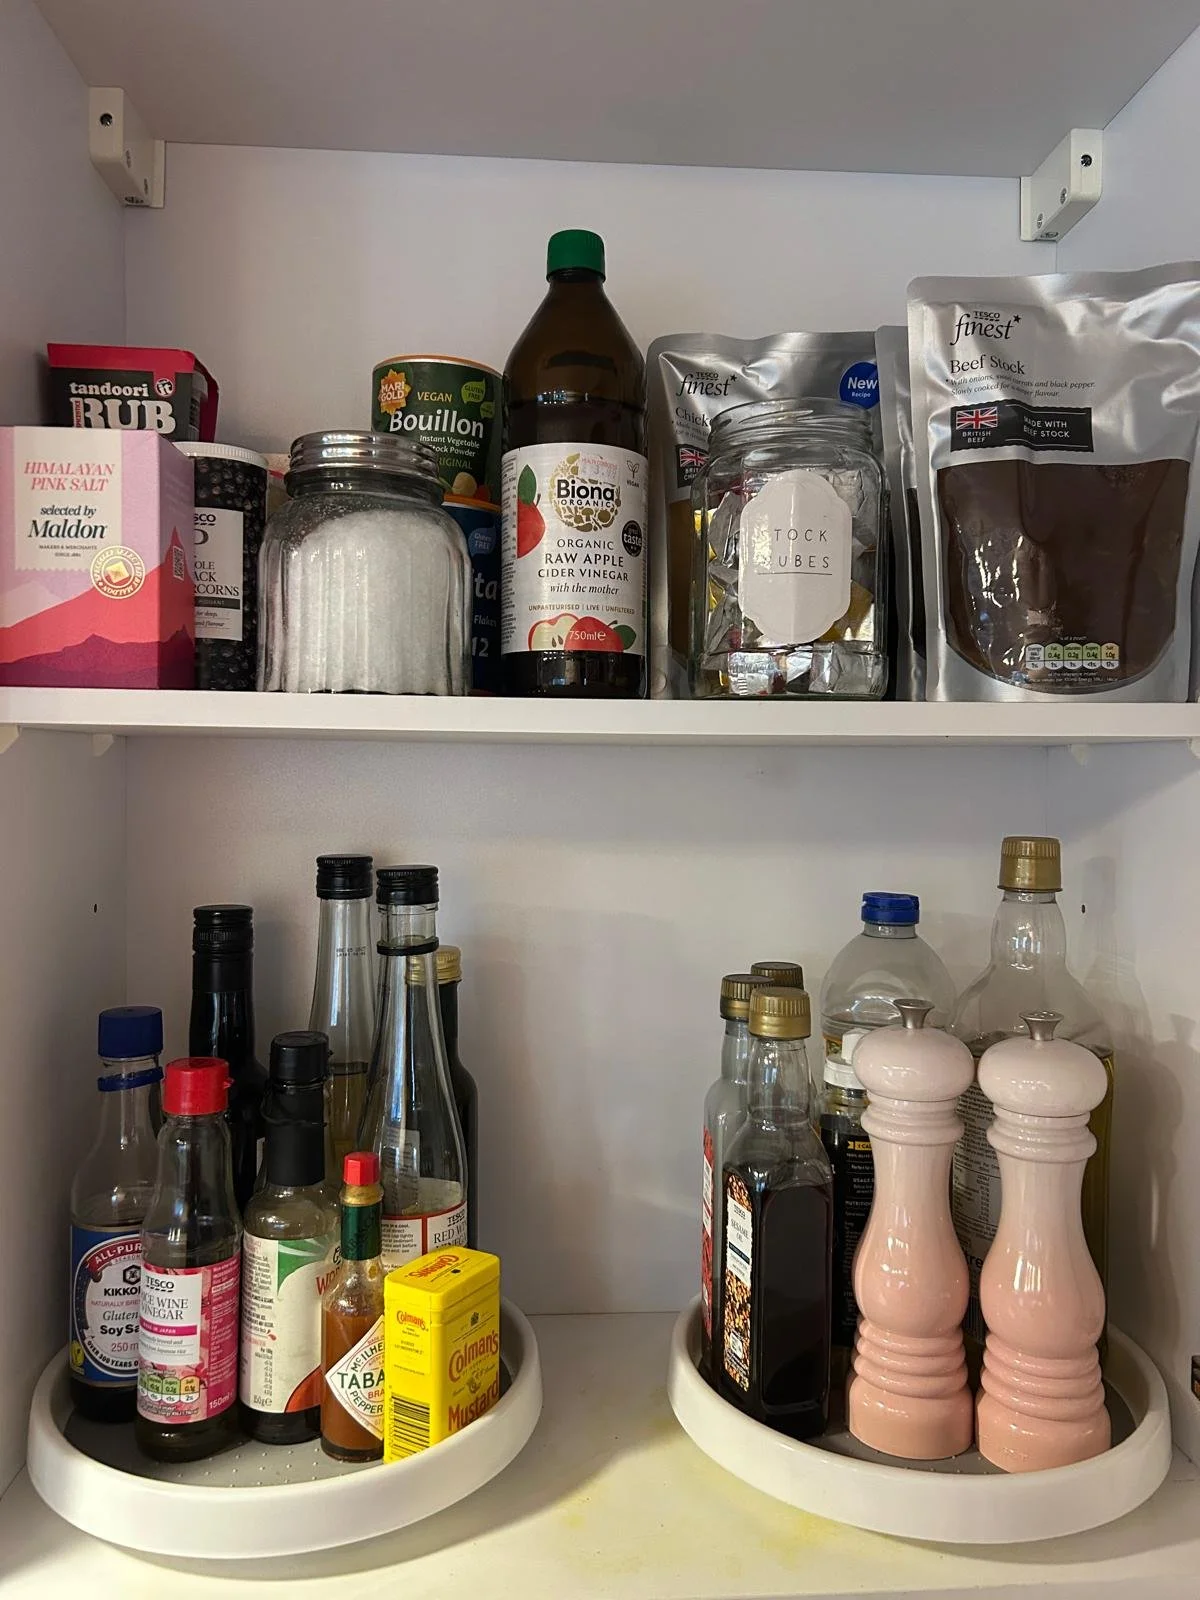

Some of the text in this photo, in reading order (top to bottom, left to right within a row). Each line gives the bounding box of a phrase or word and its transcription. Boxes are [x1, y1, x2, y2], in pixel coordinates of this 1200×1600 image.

[973, 310, 1001, 318] TESCO
[950, 313, 1015, 345] finest
[950, 354, 1025, 375] Beef Stock
[696, 371, 719, 379] TESCO
[69, 381, 149, 398] tandoori
[381, 382, 405, 394] MARI
[676, 373, 732, 397] finest
[847, 377, 878, 390] New
[974, 383, 999, 393] cooked
[1035, 380, 1048, 388] and
[1050, 380, 1067, 388] black
[381, 391, 404, 402] GOLD
[417, 391, 452, 403] VEGAN
[851, 391, 871, 399] Recipe
[70, 397, 176, 434] RUB
[676, 407, 711, 428] Chick
[1024, 416, 1067, 428] MADE WITH
[389, 408, 484, 439] Bouillon
[962, 430, 992, 438] BRITISH
[1023, 426, 1070, 438] BEEF STOCK
[419, 434, 480, 449] Instant Vegetable
[450, 446, 476, 457] Powder
[24, 461, 115, 476] HIMALAYAN
[31, 476, 109, 492] PINK SALT
[556, 479, 615, 501] Biona
[561, 499, 612, 509] ORGANIC
[40, 504, 98, 520] selected by
[194, 512, 216, 523] SCO
[28, 519, 107, 539] Maldon
[774, 529, 828, 542] TOCK
[557, 538, 614, 550] ORGANIC
[623, 532, 642, 547] taste
[194, 561, 215, 570] OLE
[544, 553, 624, 568] RAW APPLE
[778, 555, 830, 569] UBES
[537, 568, 629, 582] CIDER VINEGAR
[474, 572, 498, 600] ta
[550, 583, 620, 596] with the mother
[528, 603, 636, 615] UNPASTEURISED LIVE UNFILTERED
[472, 636, 489, 658] 12
[434, 1228, 455, 1244] RED
[95, 1242, 143, 1264] ALL-PUR
[146, 1275, 175, 1289] TESCO
[104, 1286, 141, 1296] KIKKO
[91, 1299, 141, 1308] NATURALLY BRE
[157, 1296, 189, 1310] WINE
[102, 1310, 139, 1321] Gluten
[396, 1310, 427, 1331] Colman's
[100, 1325, 124, 1337] Soy
[87, 1340, 99, 1357] OVER
[110, 1359, 133, 1368] YEARS
[111, 1343, 139, 1352] 250 m
[351, 1341, 385, 1373] McILHE
[448, 1329, 499, 1384] Colman's
[337, 1369, 385, 1390] TABA
[367, 1389, 385, 1399] BRA
[350, 1390, 384, 1415] PEPPER
[448, 1371, 499, 1432] Mustard
